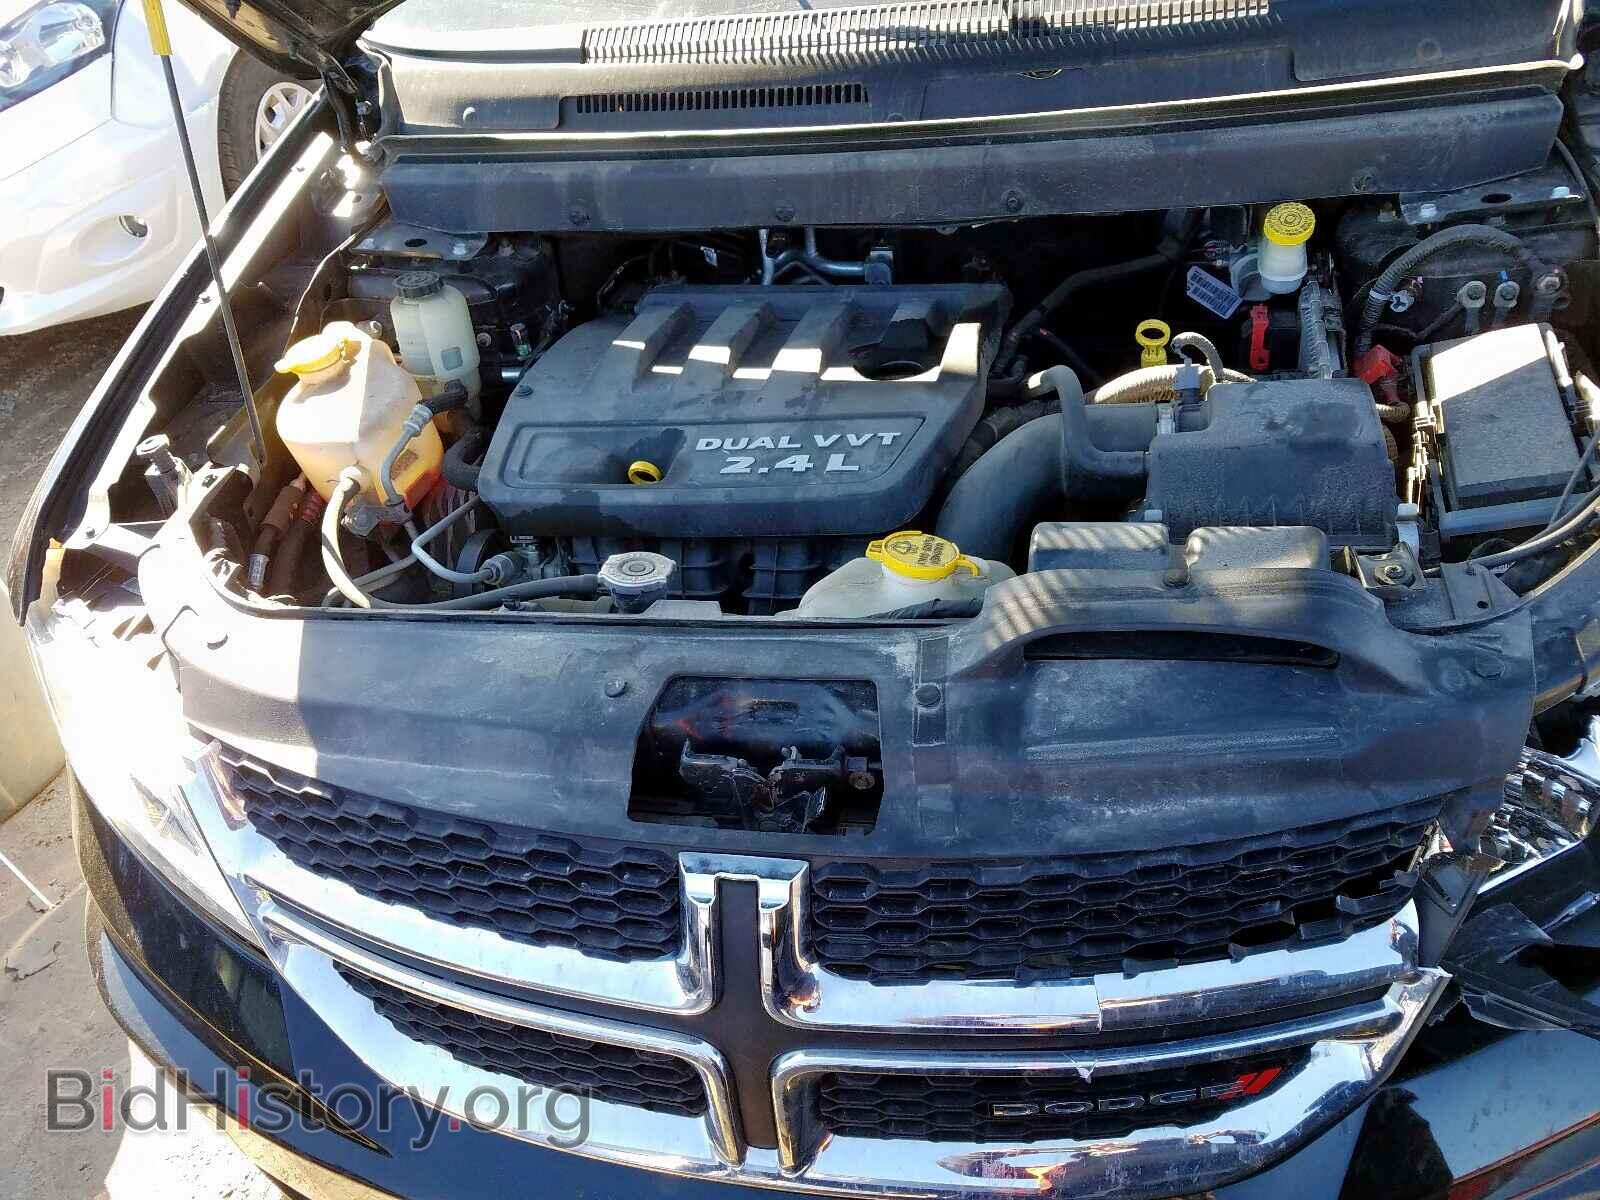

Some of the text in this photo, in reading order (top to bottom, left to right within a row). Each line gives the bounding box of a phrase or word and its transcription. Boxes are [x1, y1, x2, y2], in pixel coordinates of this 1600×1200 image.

[695, 432, 901, 451] DUAL VVT
[992, 1081, 1244, 1117] DODGE
